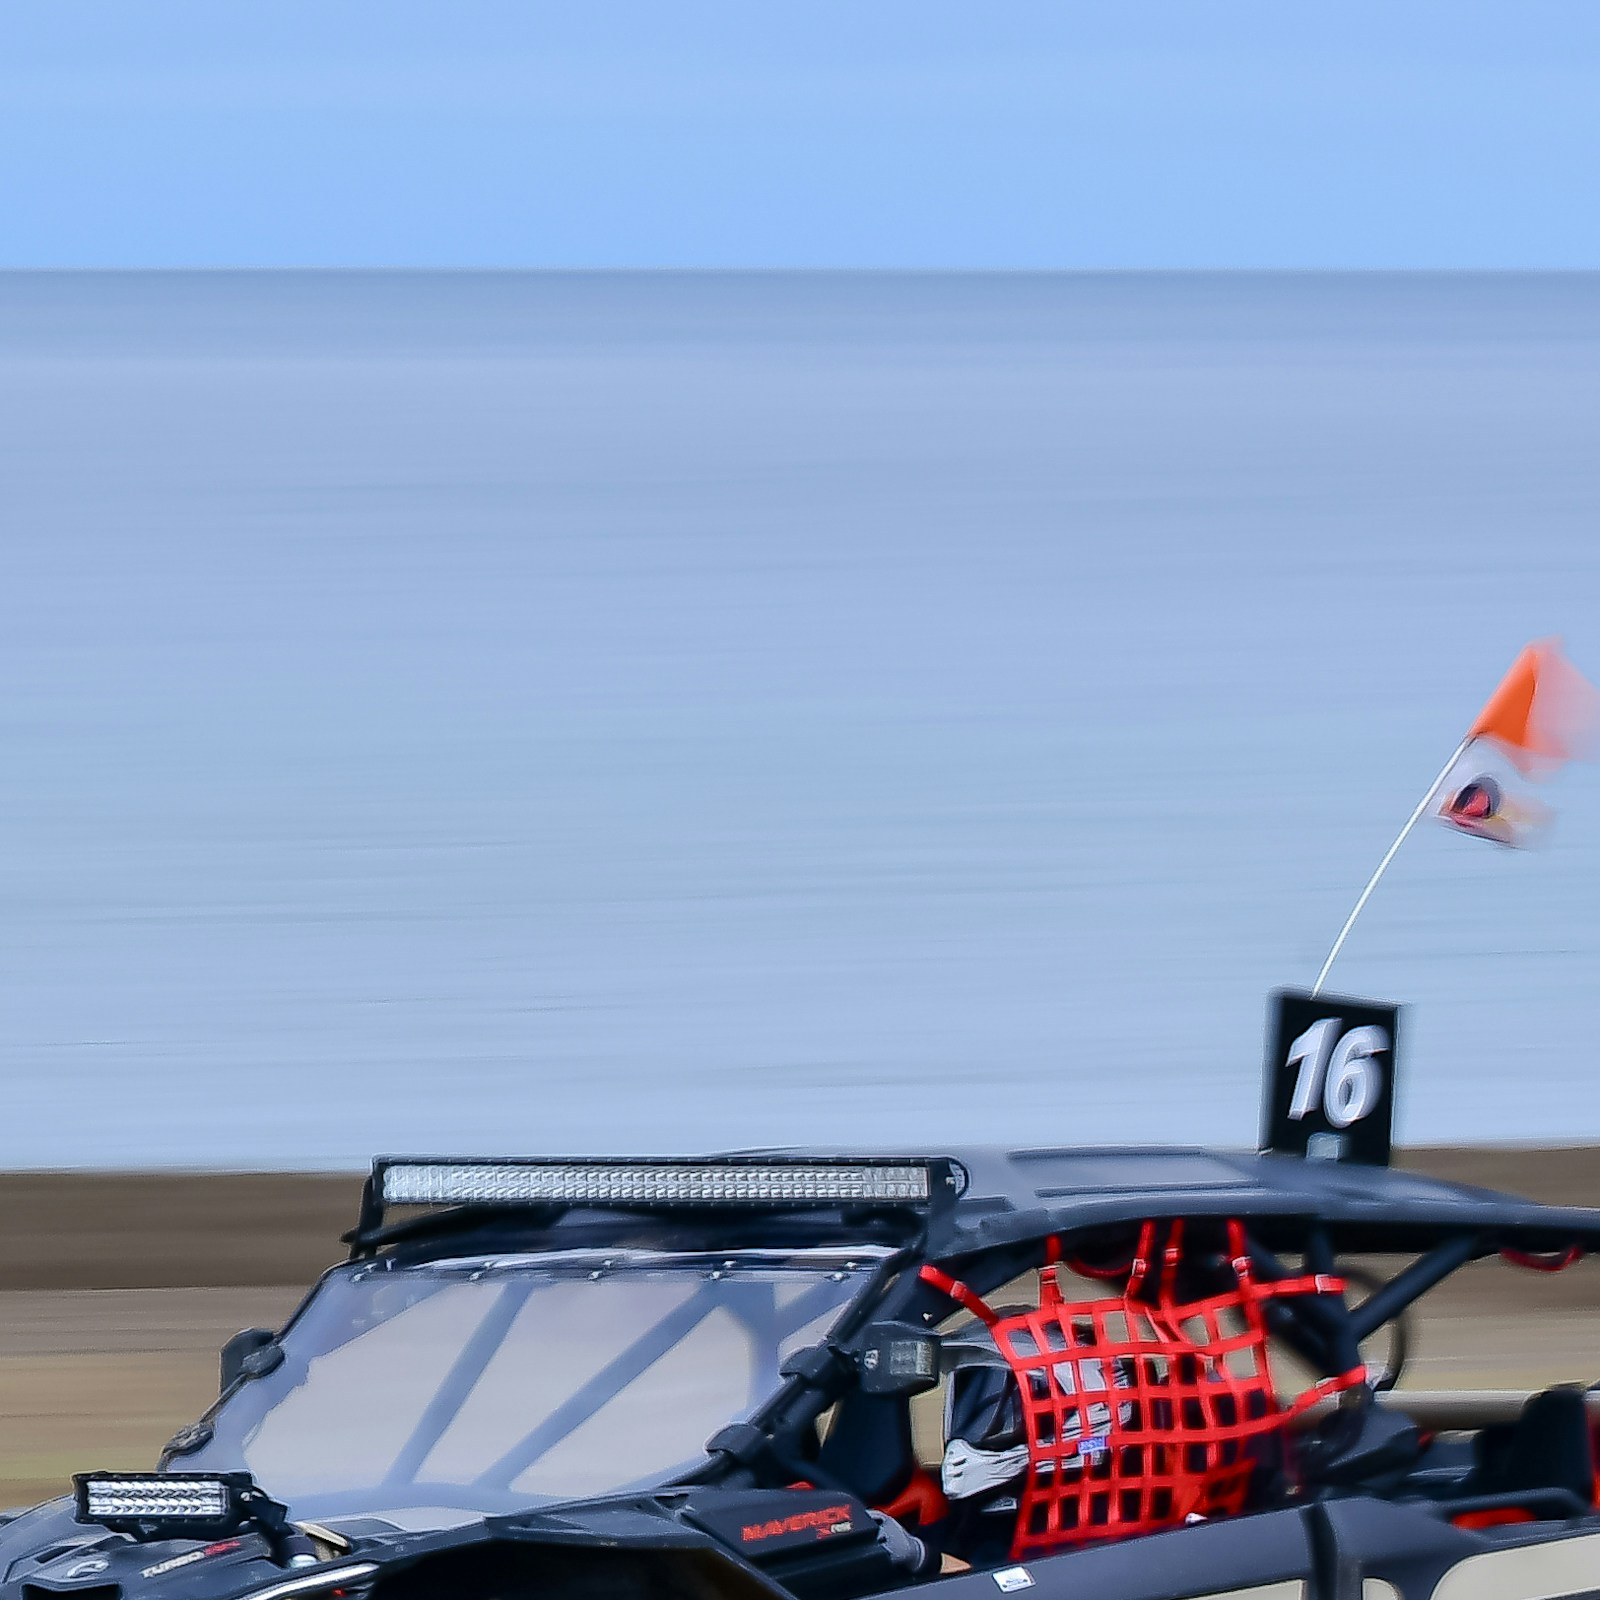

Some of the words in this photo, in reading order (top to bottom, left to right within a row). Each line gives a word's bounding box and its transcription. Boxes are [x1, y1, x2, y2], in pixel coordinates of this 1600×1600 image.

[1285, 1016, 1390, 1129] 16
[742, 1503, 852, 1542] MAVERICK
[140, 1550, 205, 1579] TURBO
